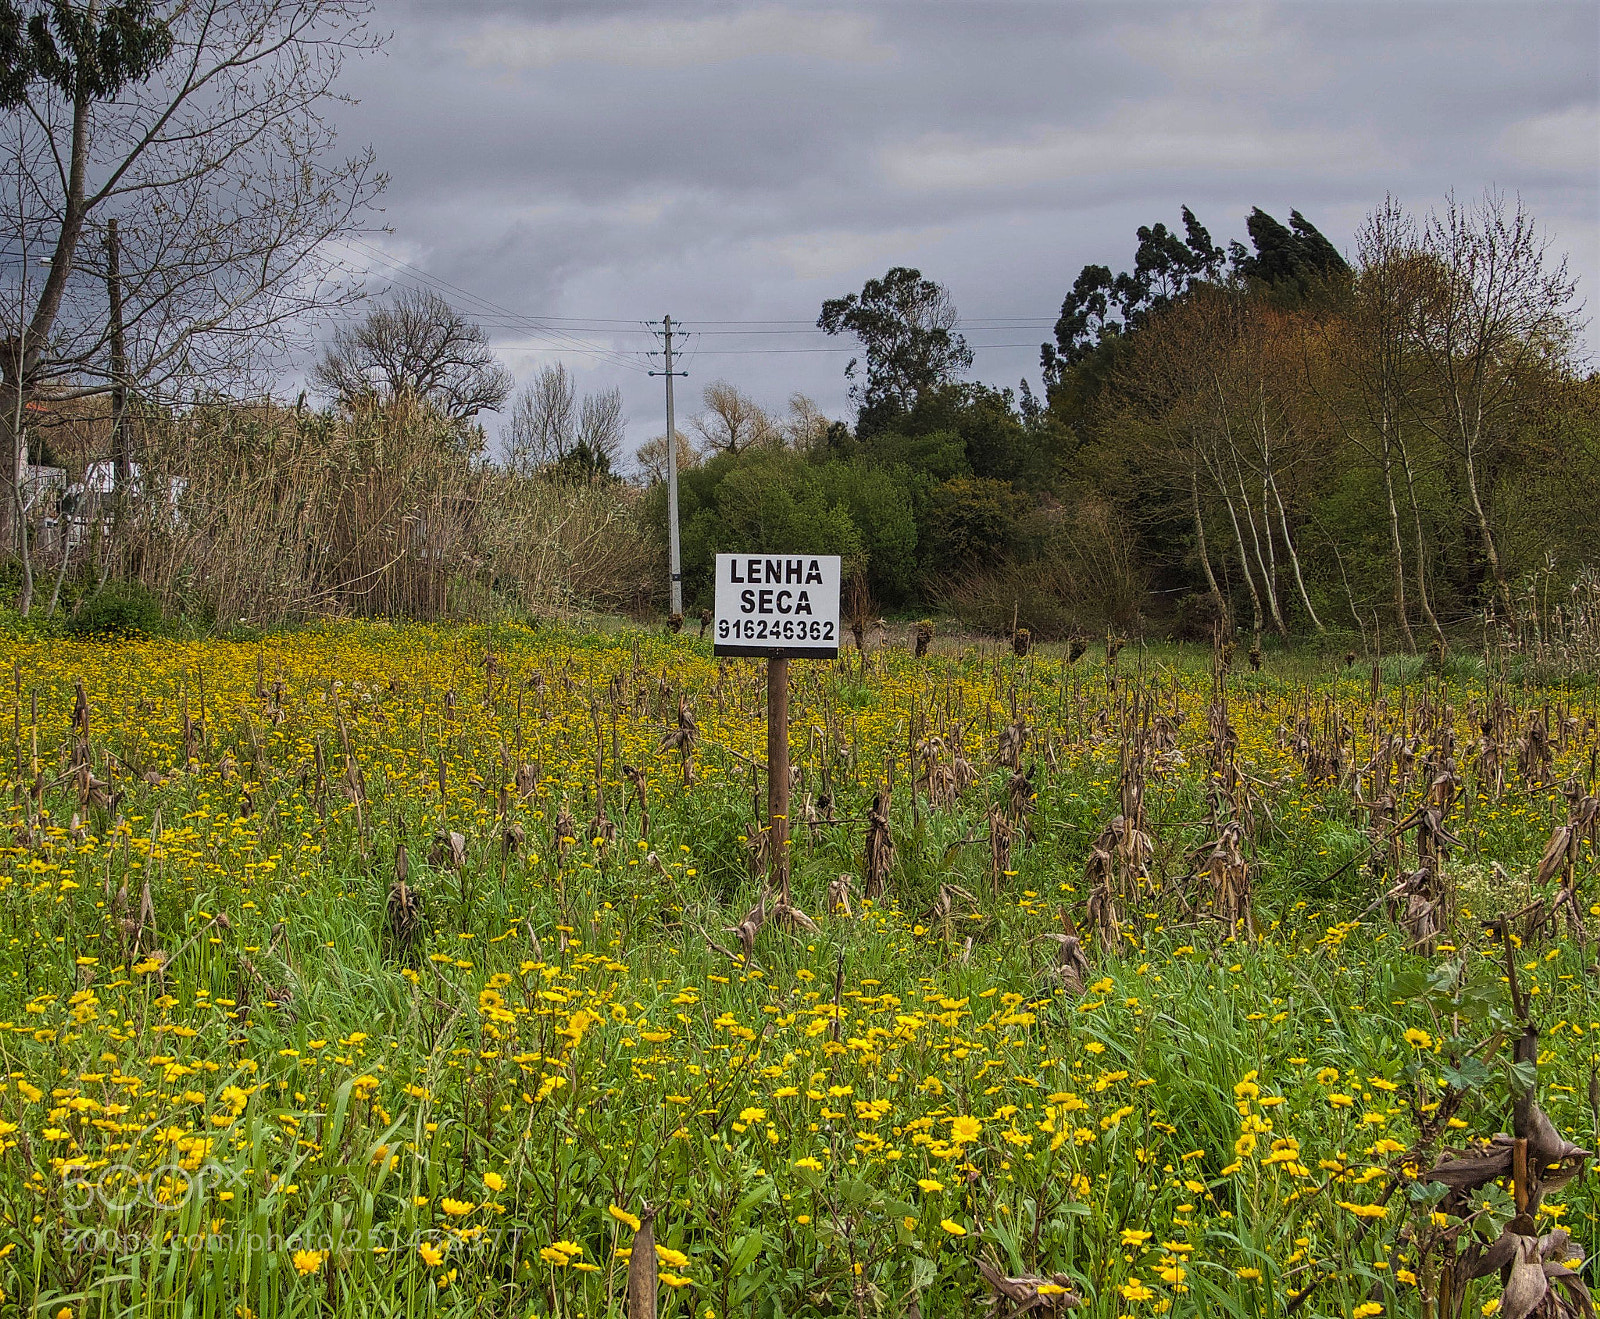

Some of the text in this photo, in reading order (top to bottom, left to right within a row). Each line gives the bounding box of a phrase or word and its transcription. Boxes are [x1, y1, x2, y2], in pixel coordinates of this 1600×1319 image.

[730, 559, 823, 585] LENHA
[740, 589, 813, 615] SECA
[718, 619, 835, 641] 916246362
